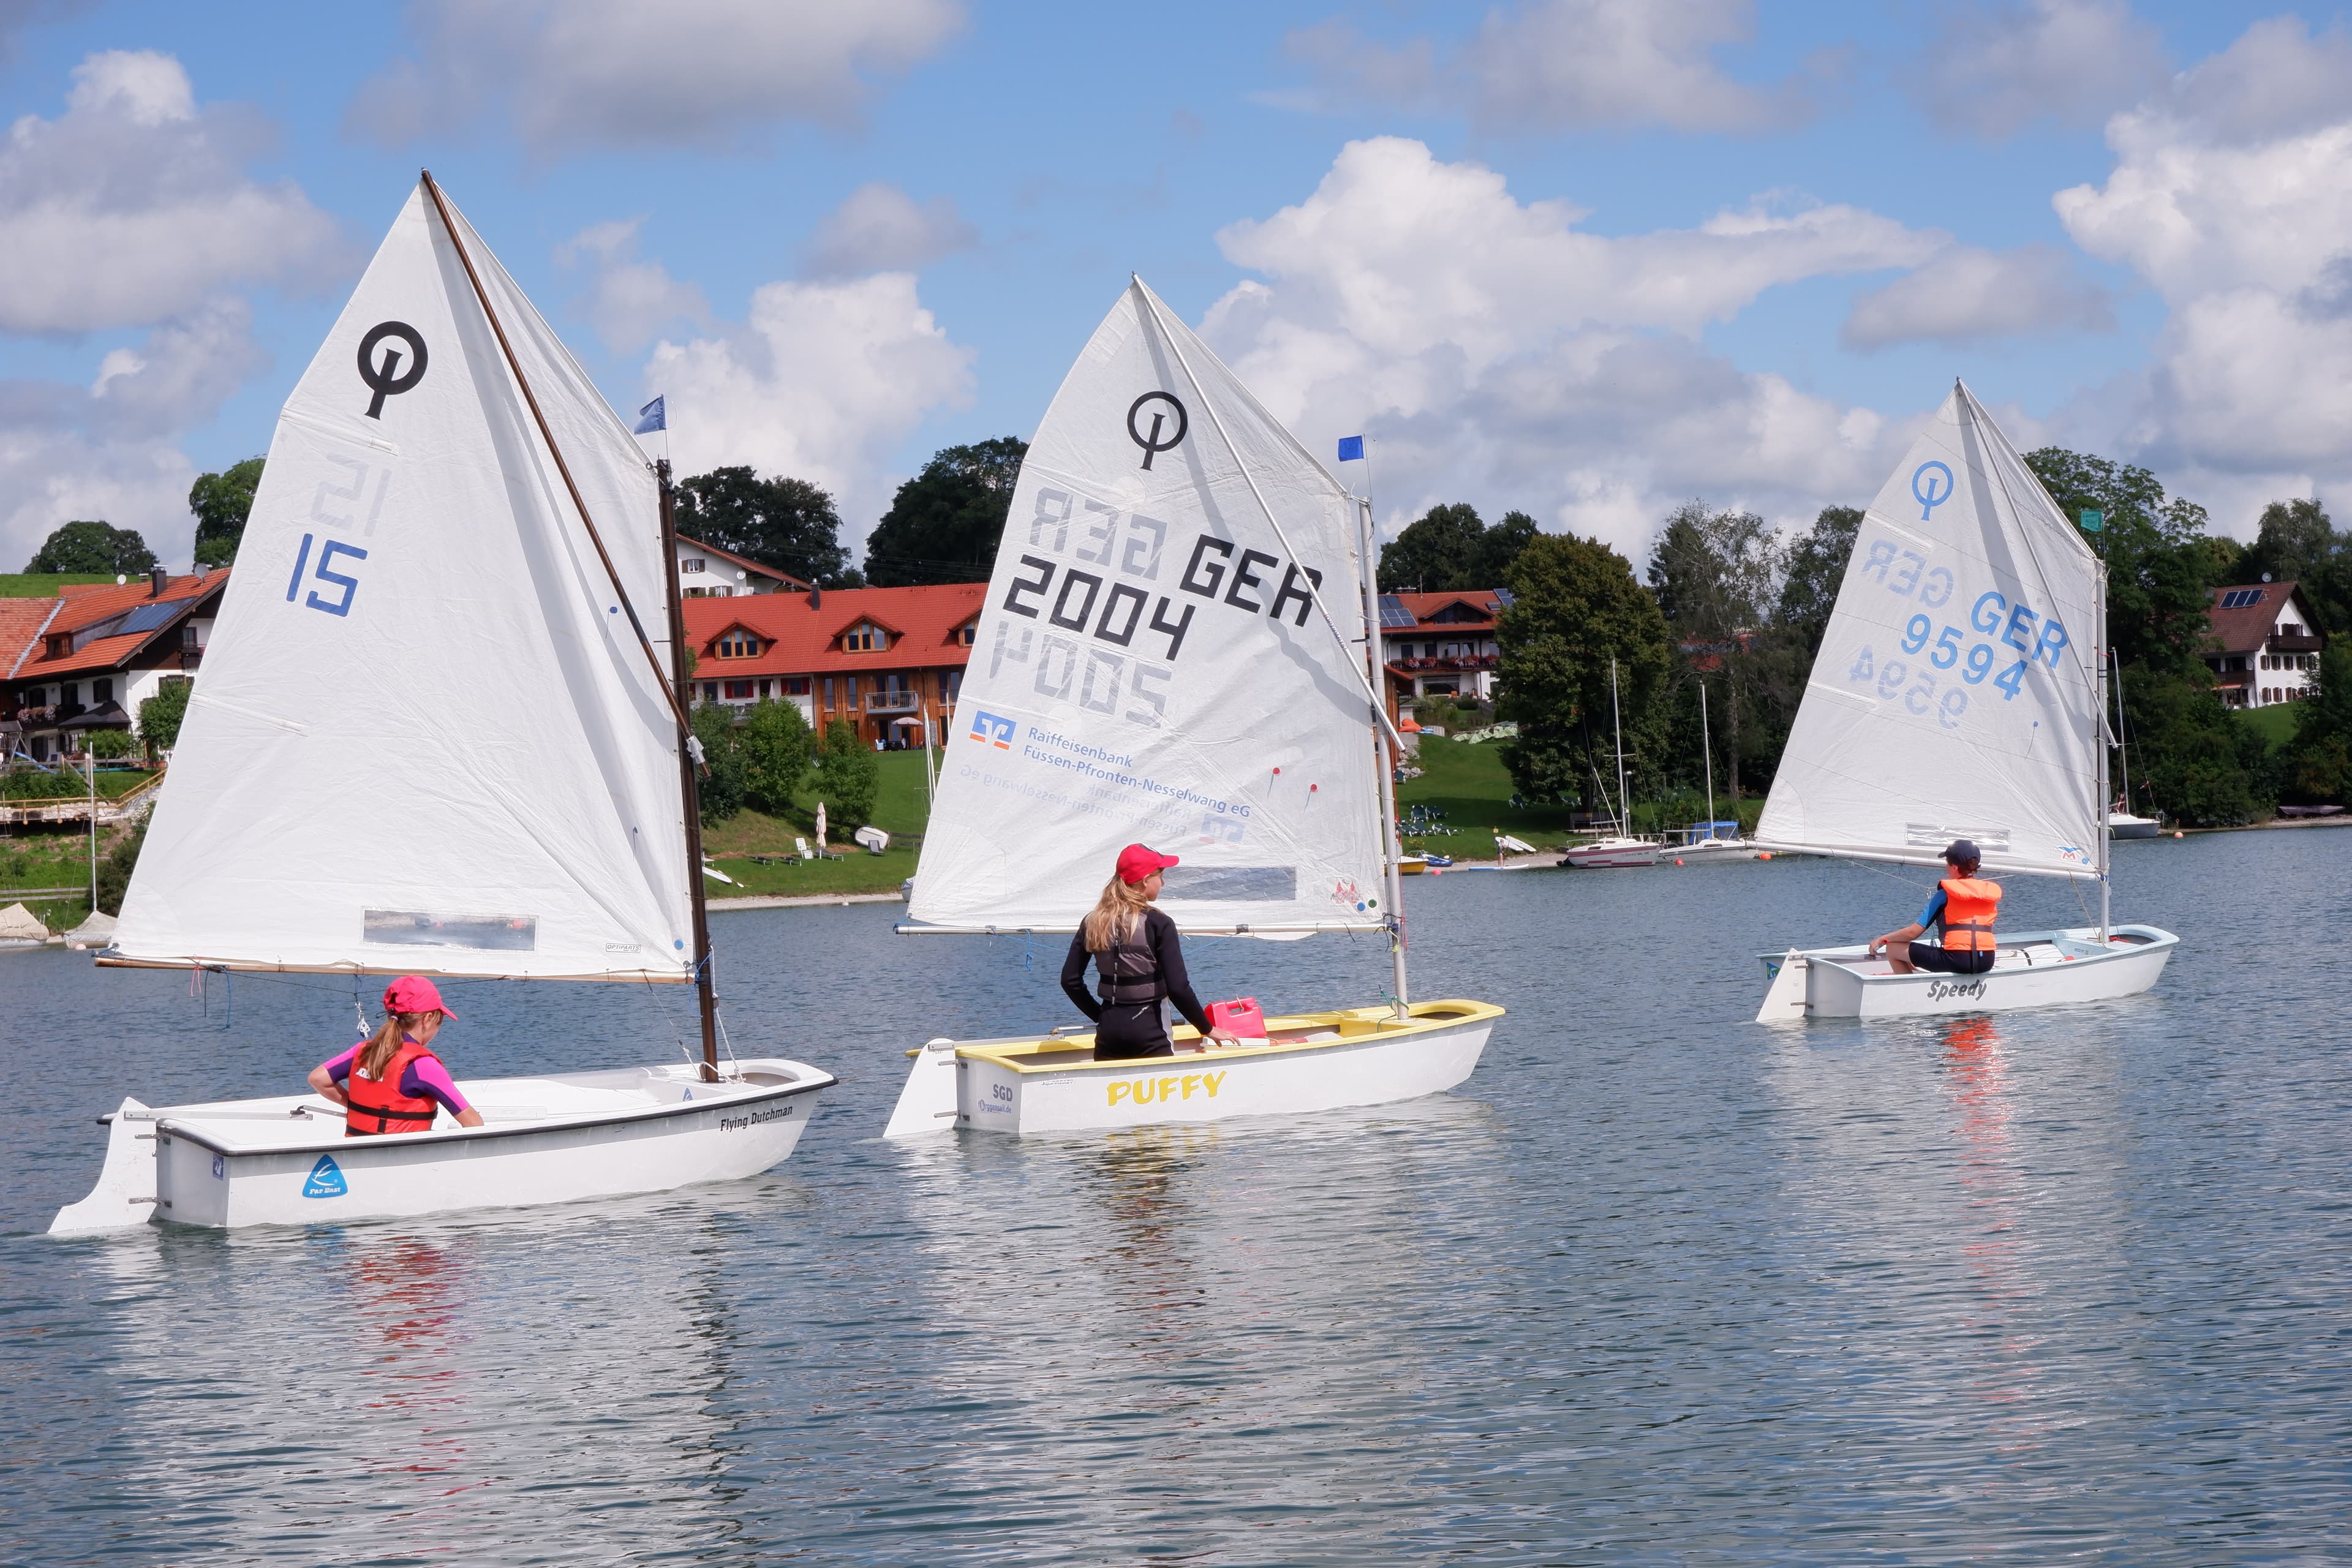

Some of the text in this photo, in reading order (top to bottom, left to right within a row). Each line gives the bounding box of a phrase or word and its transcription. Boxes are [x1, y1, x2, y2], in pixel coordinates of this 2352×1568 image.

[286, 533, 368, 617] 15
[1003, 554, 1196, 662] 2004
[1179, 534, 1322, 627] GER
[1901, 614, 2028, 701] 9594
[1970, 590, 2068, 669] GER
[1023, 745, 1251, 818] Füssen-Pfronten-Nesselwang eG
[1028, 726, 1133, 767] Raiffeisenbank
[1927, 979, 1987, 1002] Speedy
[720, 1106, 793, 1133] Flying Dutchman
[993, 1084, 1012, 1102] SGD
[1107, 1070, 1227, 1106] PUFFY
